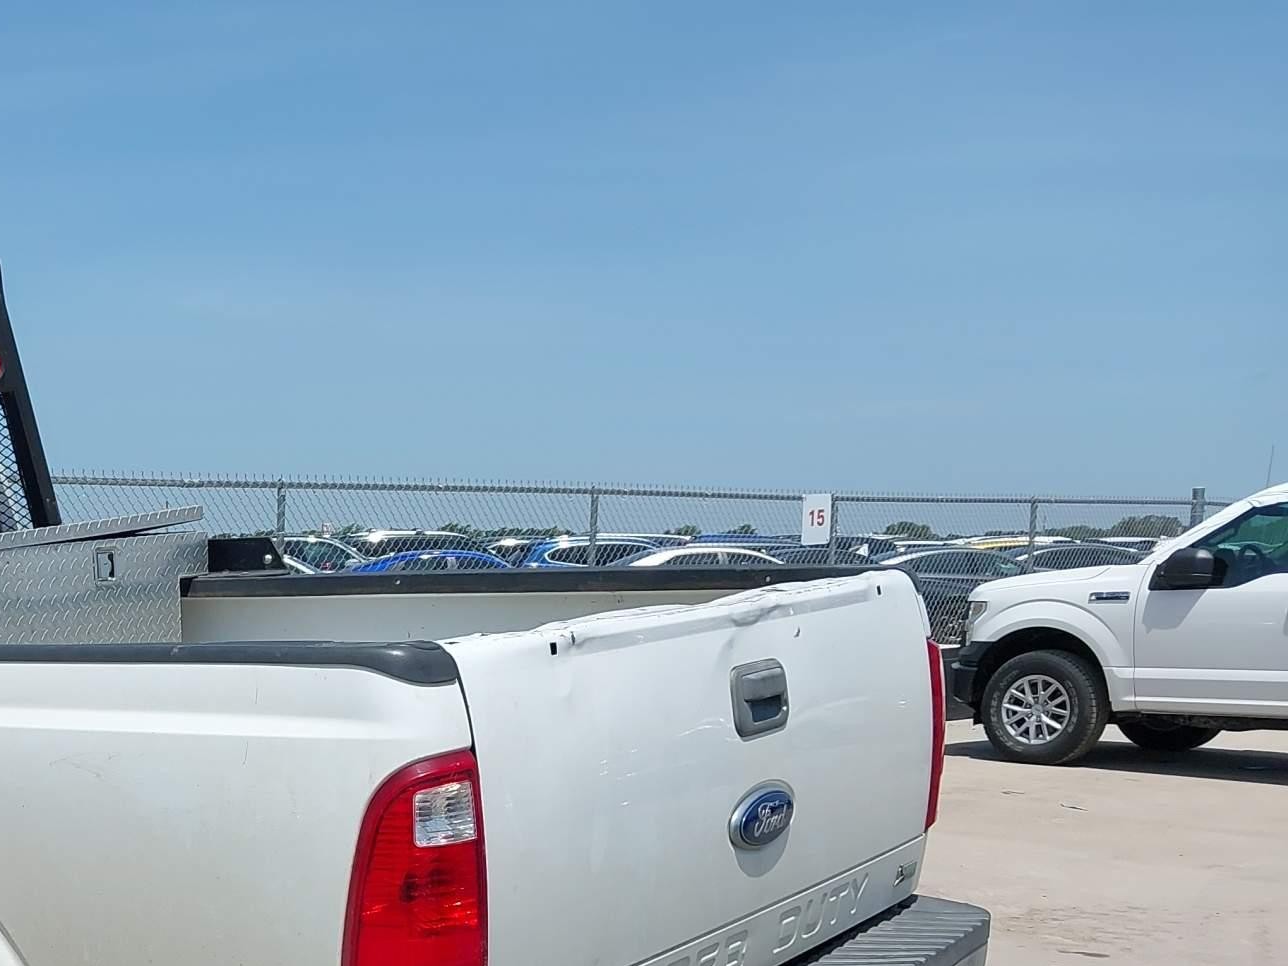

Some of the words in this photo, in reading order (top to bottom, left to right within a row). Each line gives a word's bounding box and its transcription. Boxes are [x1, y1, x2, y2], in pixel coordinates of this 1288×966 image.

[808, 508, 825, 527] 15
[753, 800, 788, 838] Ford
[772, 871, 870, 955] DUTY
